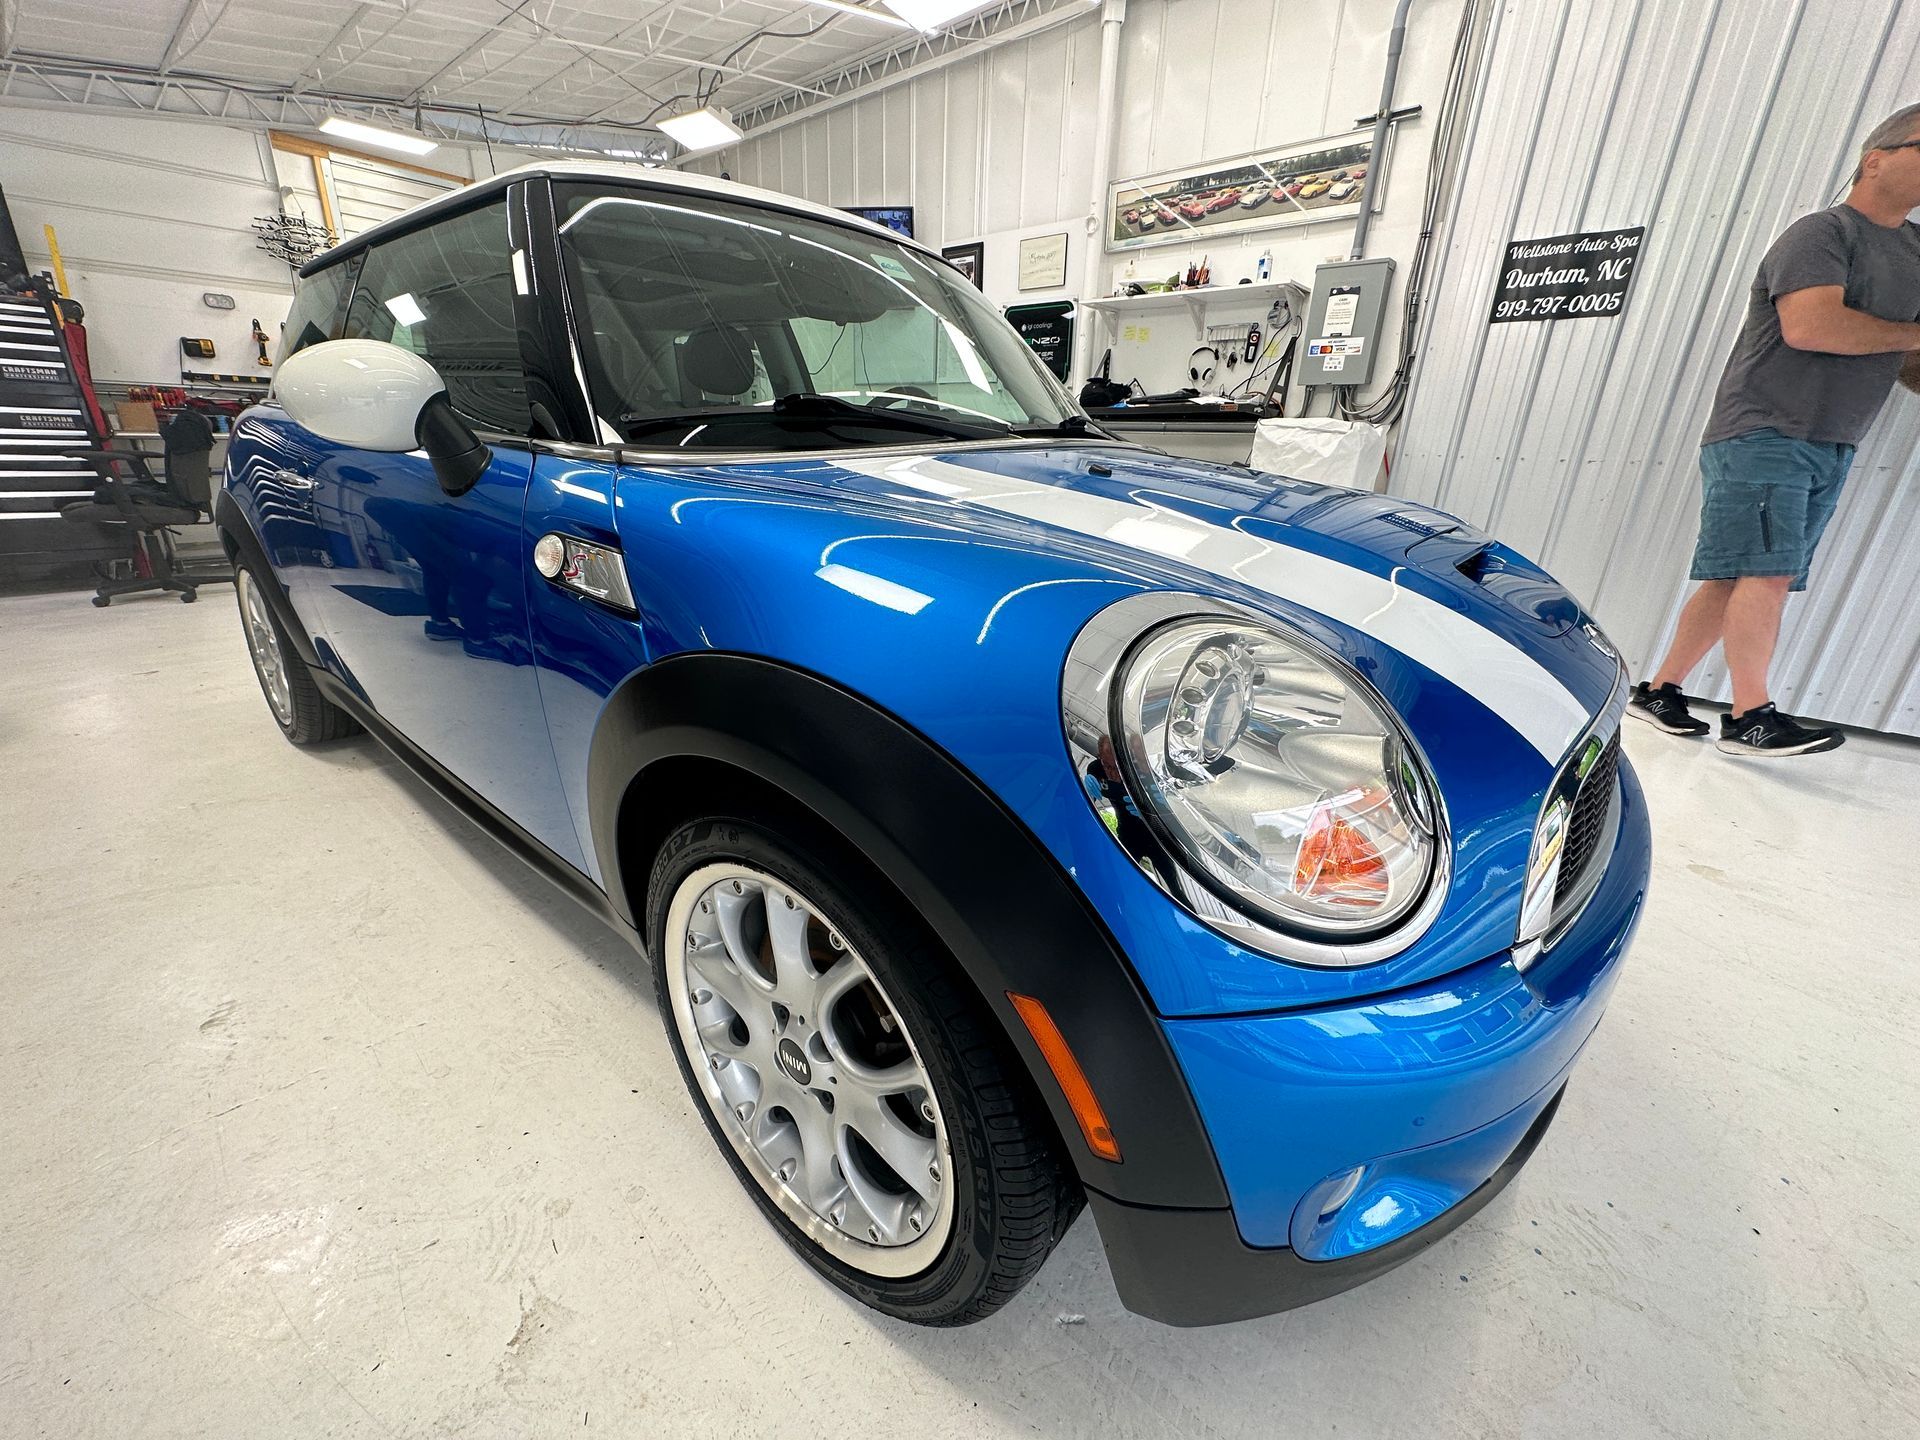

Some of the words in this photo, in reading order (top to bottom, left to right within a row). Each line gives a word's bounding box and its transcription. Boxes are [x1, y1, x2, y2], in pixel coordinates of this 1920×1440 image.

[1510, 242, 1572, 260] Wellstone
[1574, 238, 1610, 254] Auto
[1611, 234, 1640, 253] Spa
[1505, 266, 1590, 289] Durham,
[1597, 257, 1632, 282] NC
[1495, 291, 1624, 318] 919-797-0005
[2, 366, 57, 375] CRAFTSMAN
[782, 1050, 808, 1075] MINI
